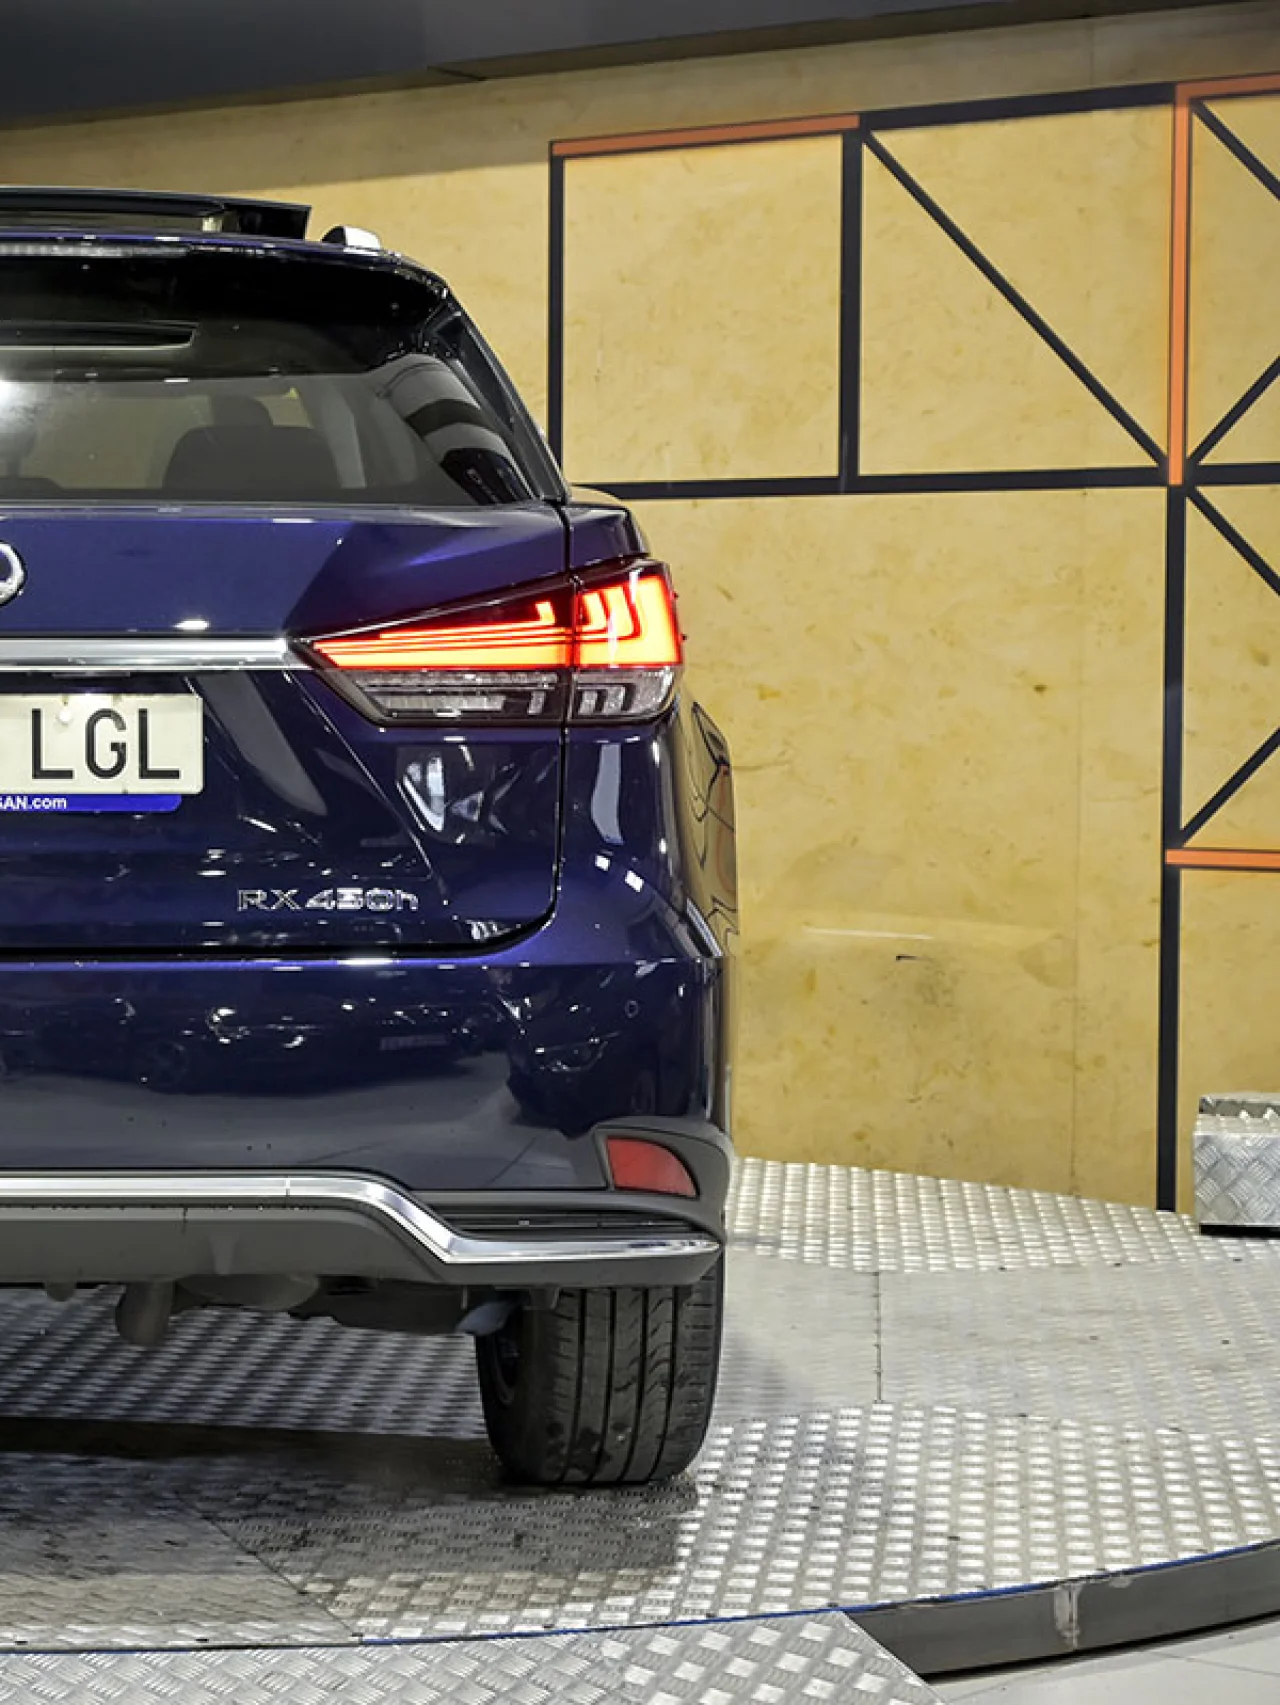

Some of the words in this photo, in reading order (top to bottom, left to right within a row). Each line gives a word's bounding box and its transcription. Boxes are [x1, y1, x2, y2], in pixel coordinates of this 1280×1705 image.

[31, 708, 181, 781] LGL
[237, 888, 302, 912] RX
[305, 887, 419, 911] 450h
